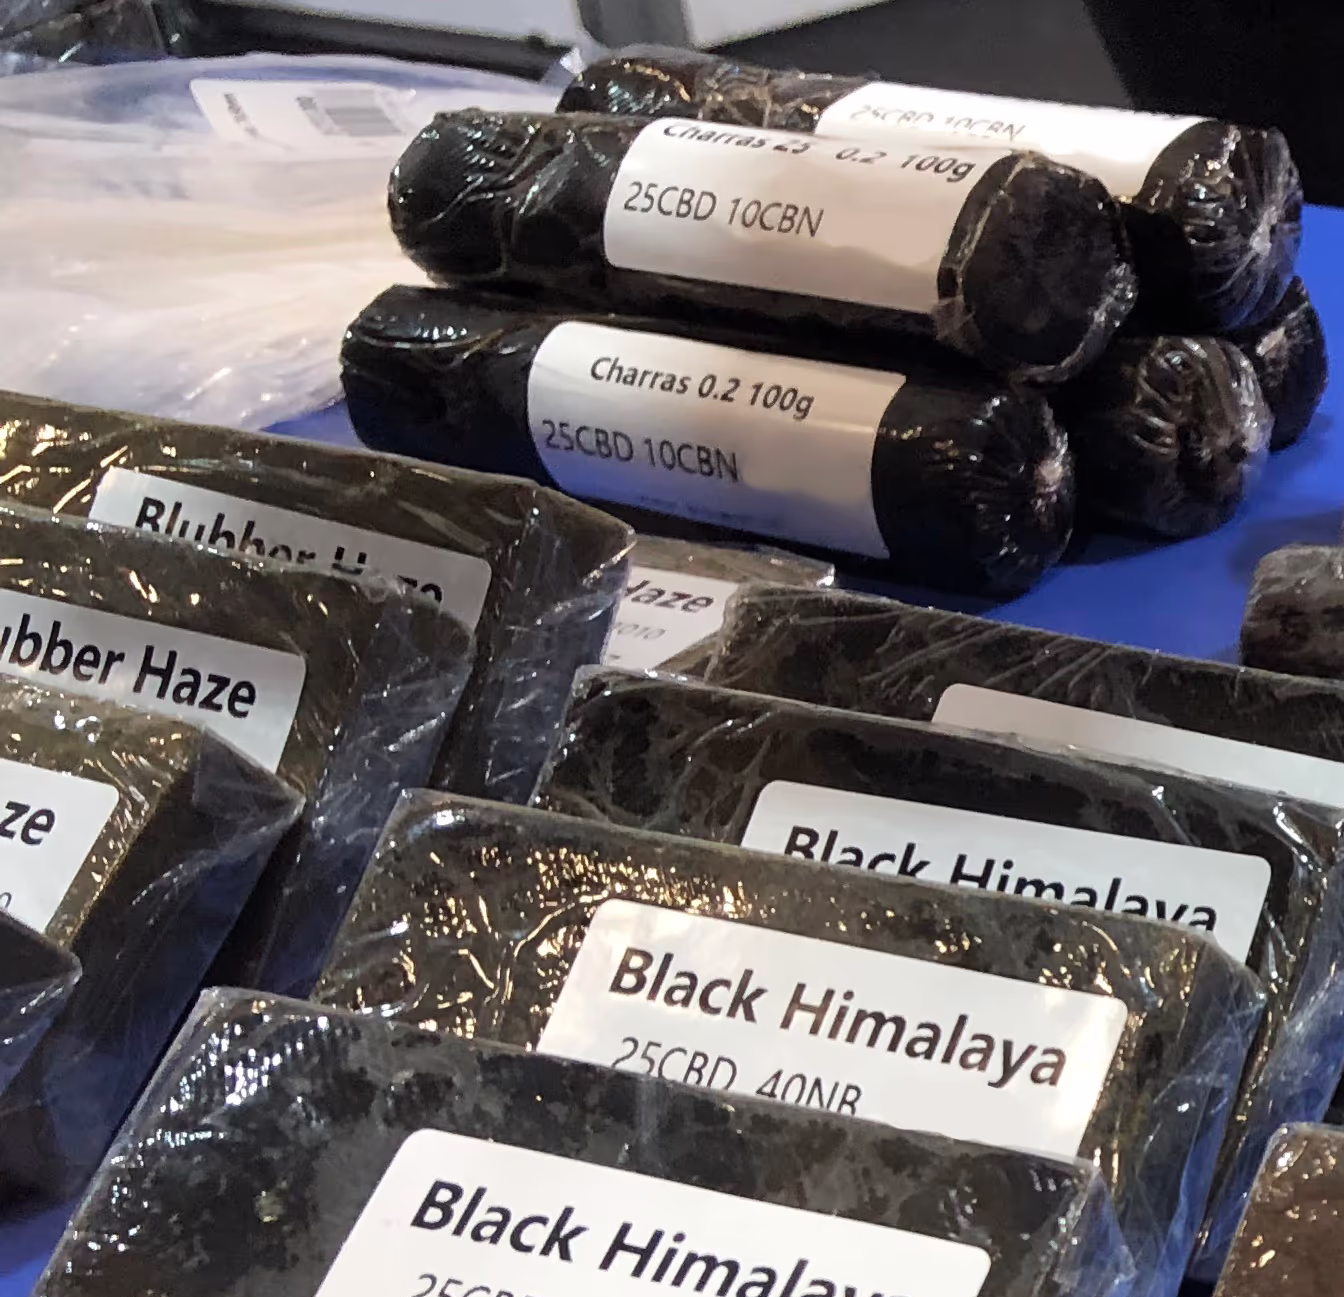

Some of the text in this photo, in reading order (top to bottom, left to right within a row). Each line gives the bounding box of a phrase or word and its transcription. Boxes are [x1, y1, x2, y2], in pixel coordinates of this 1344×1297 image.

[663, 123, 977, 183] Charras 25 0.2 100g
[623, 180, 825, 238] 25CBD 10CBN
[590, 356, 815, 421] Charras 0.2 100g
[542, 418, 740, 483] 25CBD 10CBN
[132, 644, 257, 719] Haze
[783, 825, 931, 879] Black
[609, 946, 1068, 1089] Black Himalaya
[611, 1036, 864, 1117] 25CBD 40NB
[410, 1179, 590, 1263] Black
